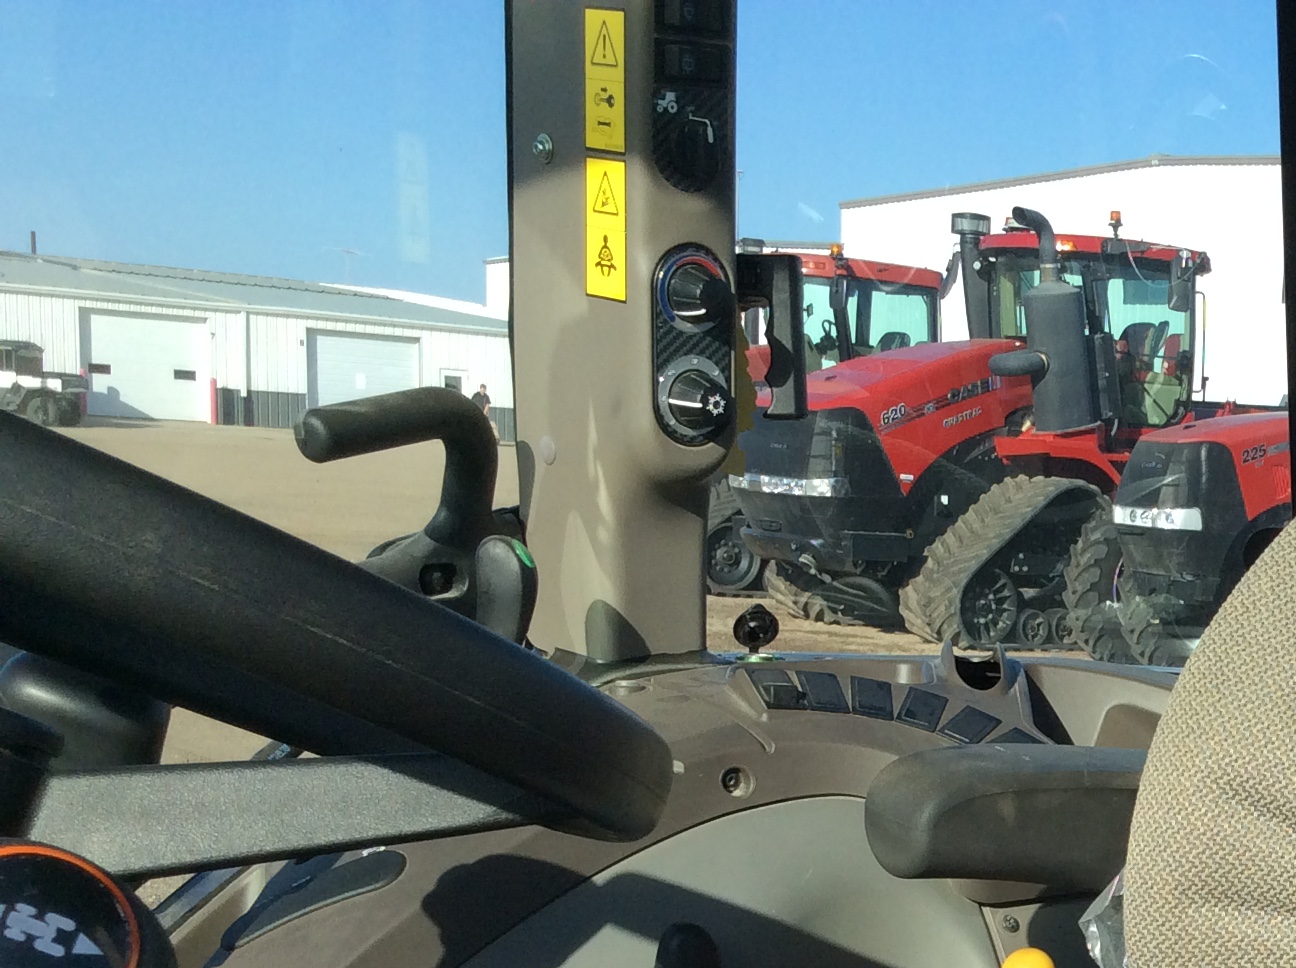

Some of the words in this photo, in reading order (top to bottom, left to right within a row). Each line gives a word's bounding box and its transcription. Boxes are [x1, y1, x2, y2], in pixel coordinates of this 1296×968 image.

[947, 378, 990, 403] CASE
[881, 403, 906, 425] 620
[1242, 443, 1266, 464] 225
